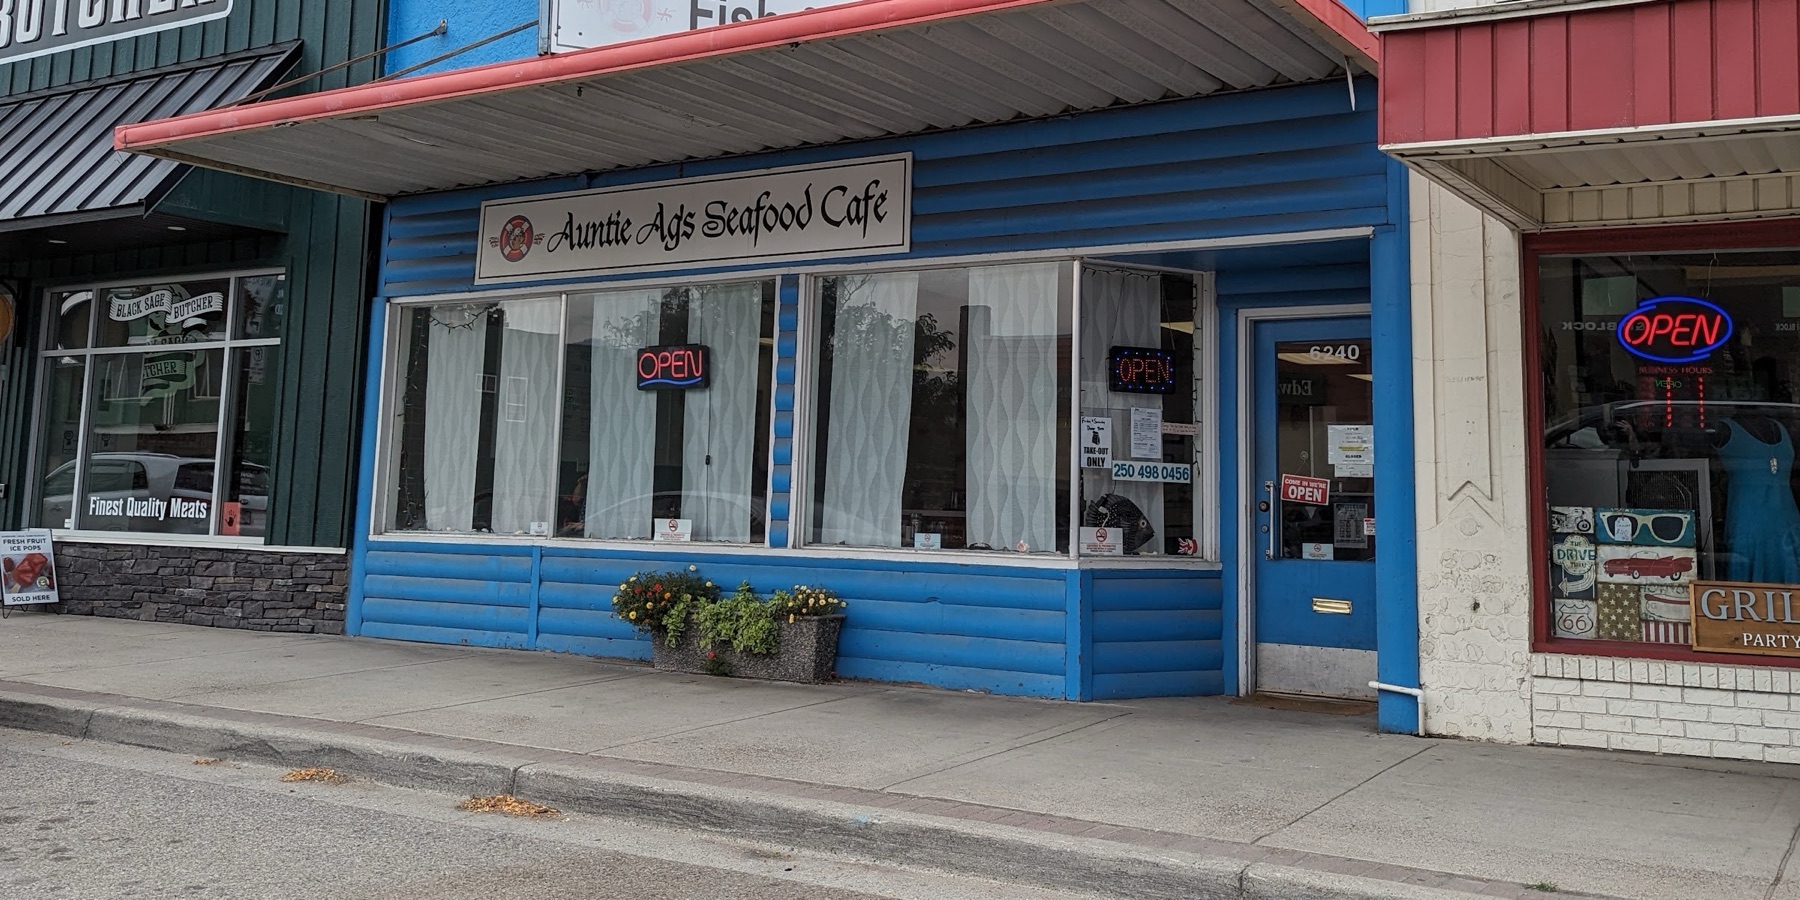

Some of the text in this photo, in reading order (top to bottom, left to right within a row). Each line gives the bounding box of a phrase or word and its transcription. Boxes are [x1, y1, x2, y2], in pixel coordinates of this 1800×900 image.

[547, 210, 632, 252] Auntie
[636, 202, 696, 251] Ag's
[701, 183, 813, 248] Seafood
[116, 293, 213, 319] BLACK SAGE BUTCHER
[1623, 314, 1722, 346] OPEN
[1309, 344, 1360, 361] 6240
[639, 349, 703, 379] OPEN
[1120, 358, 1170, 383] OPEN
[1681, 366, 1713, 374] HOURS
[1083, 446, 1109, 455] TAKE-OUT
[1087, 456, 1106, 467] ONLY
[1113, 463, 1190, 481] 250 498 0456
[1284, 478, 1301, 486] COME
[1288, 485, 1322, 502] OPEN
[89, 496, 207, 521] Finest Quality Meats
[1557, 548, 1596, 561] DRIVE
[1563, 614, 1587, 631] 66
